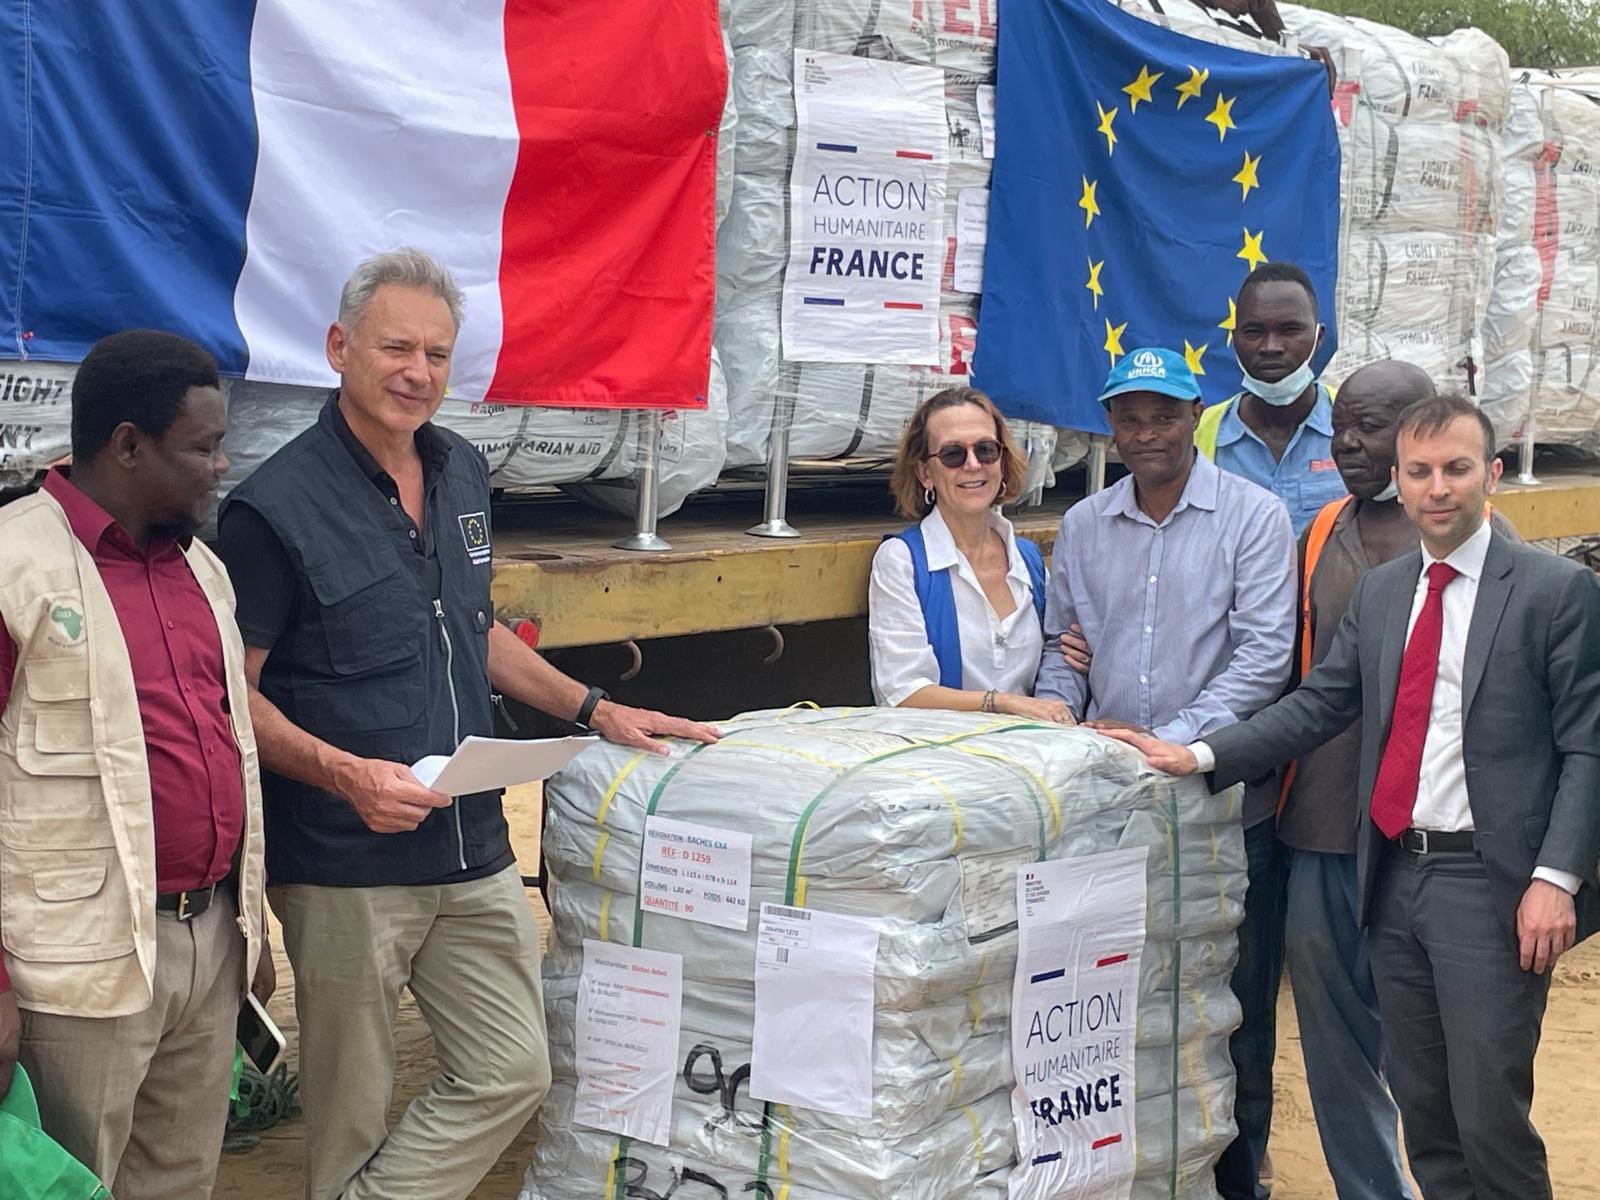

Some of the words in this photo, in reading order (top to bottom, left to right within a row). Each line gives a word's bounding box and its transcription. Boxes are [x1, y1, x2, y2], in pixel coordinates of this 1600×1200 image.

[813, 174, 927, 212] ACTION
[813, 216, 926, 241] HUMANITAIRE
[810, 246, 924, 281] FRANCE
[576, 442, 602, 455] AID
[646, 862, 678, 875] DIMENSION
[683, 850, 689, 859] D
[692, 852, 712, 864] 1259
[644, 880, 668, 892] VOLUME
[1025, 989, 1122, 1049] ACTION
[1024, 1037, 1121, 1086] HUMANITAIRE
